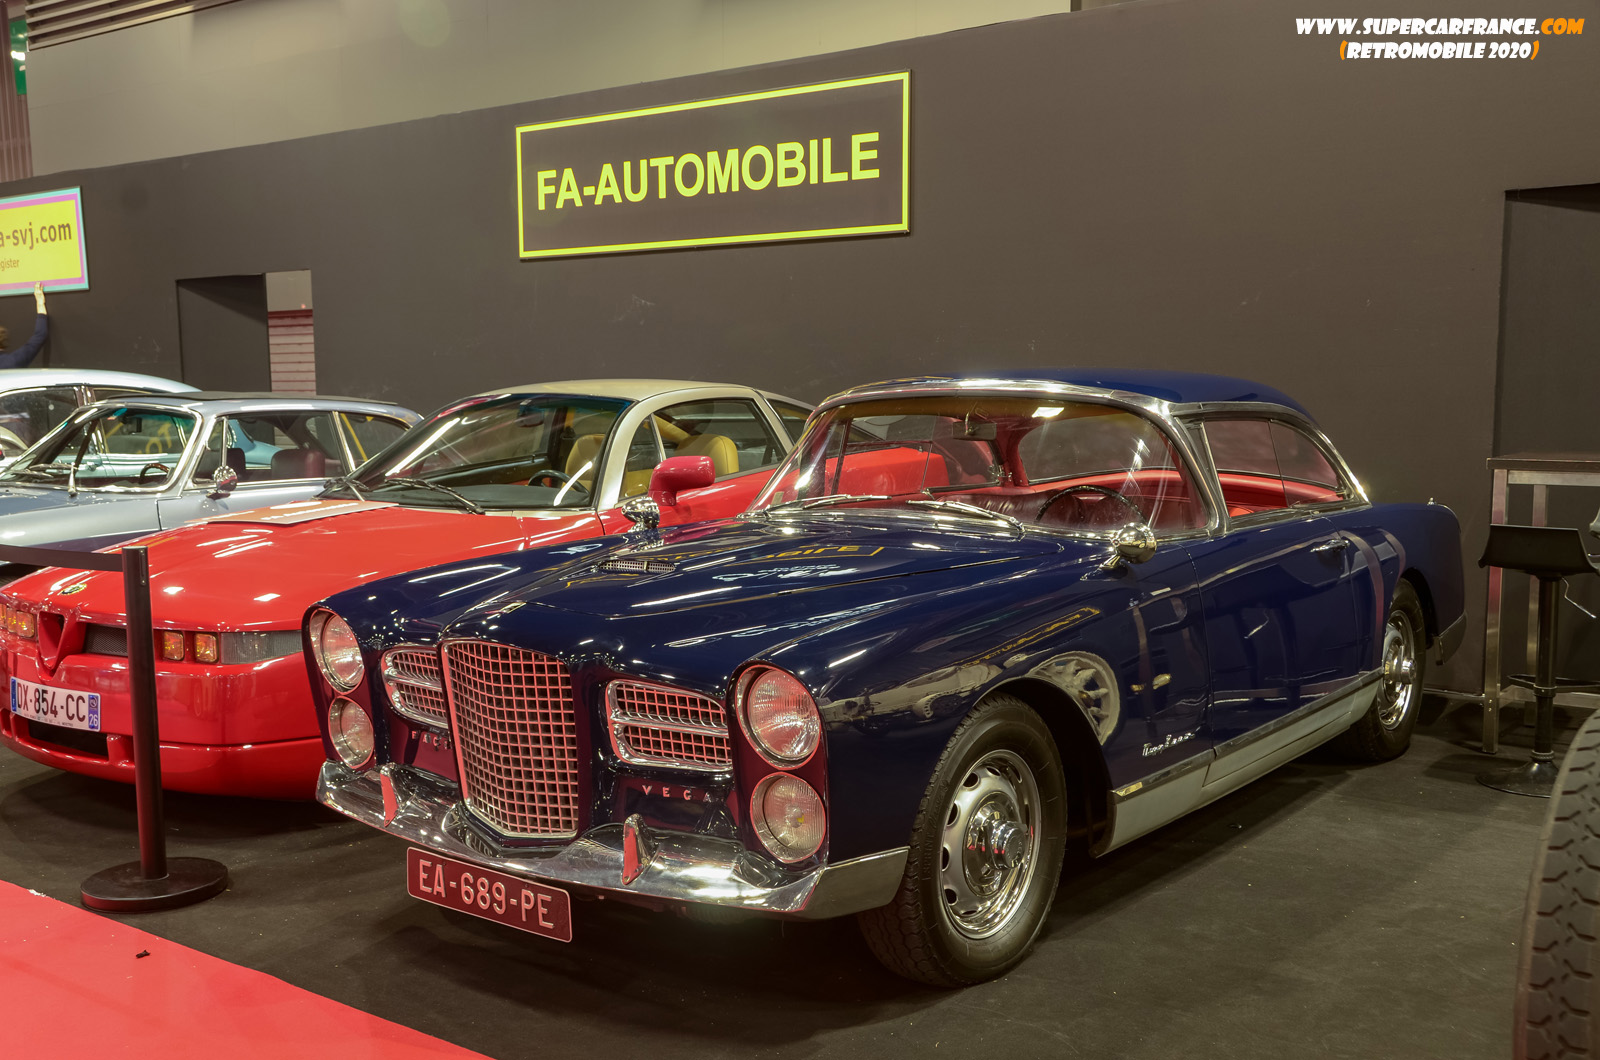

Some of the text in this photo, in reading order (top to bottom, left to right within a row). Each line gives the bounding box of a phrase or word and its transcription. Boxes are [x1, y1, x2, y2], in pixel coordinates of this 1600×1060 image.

[537, 132, 880, 211] FA-AUTOMOBILE
[17, 682, 86, 722] DX-854-CC
[418, 858, 555, 929] EA-689-PE
